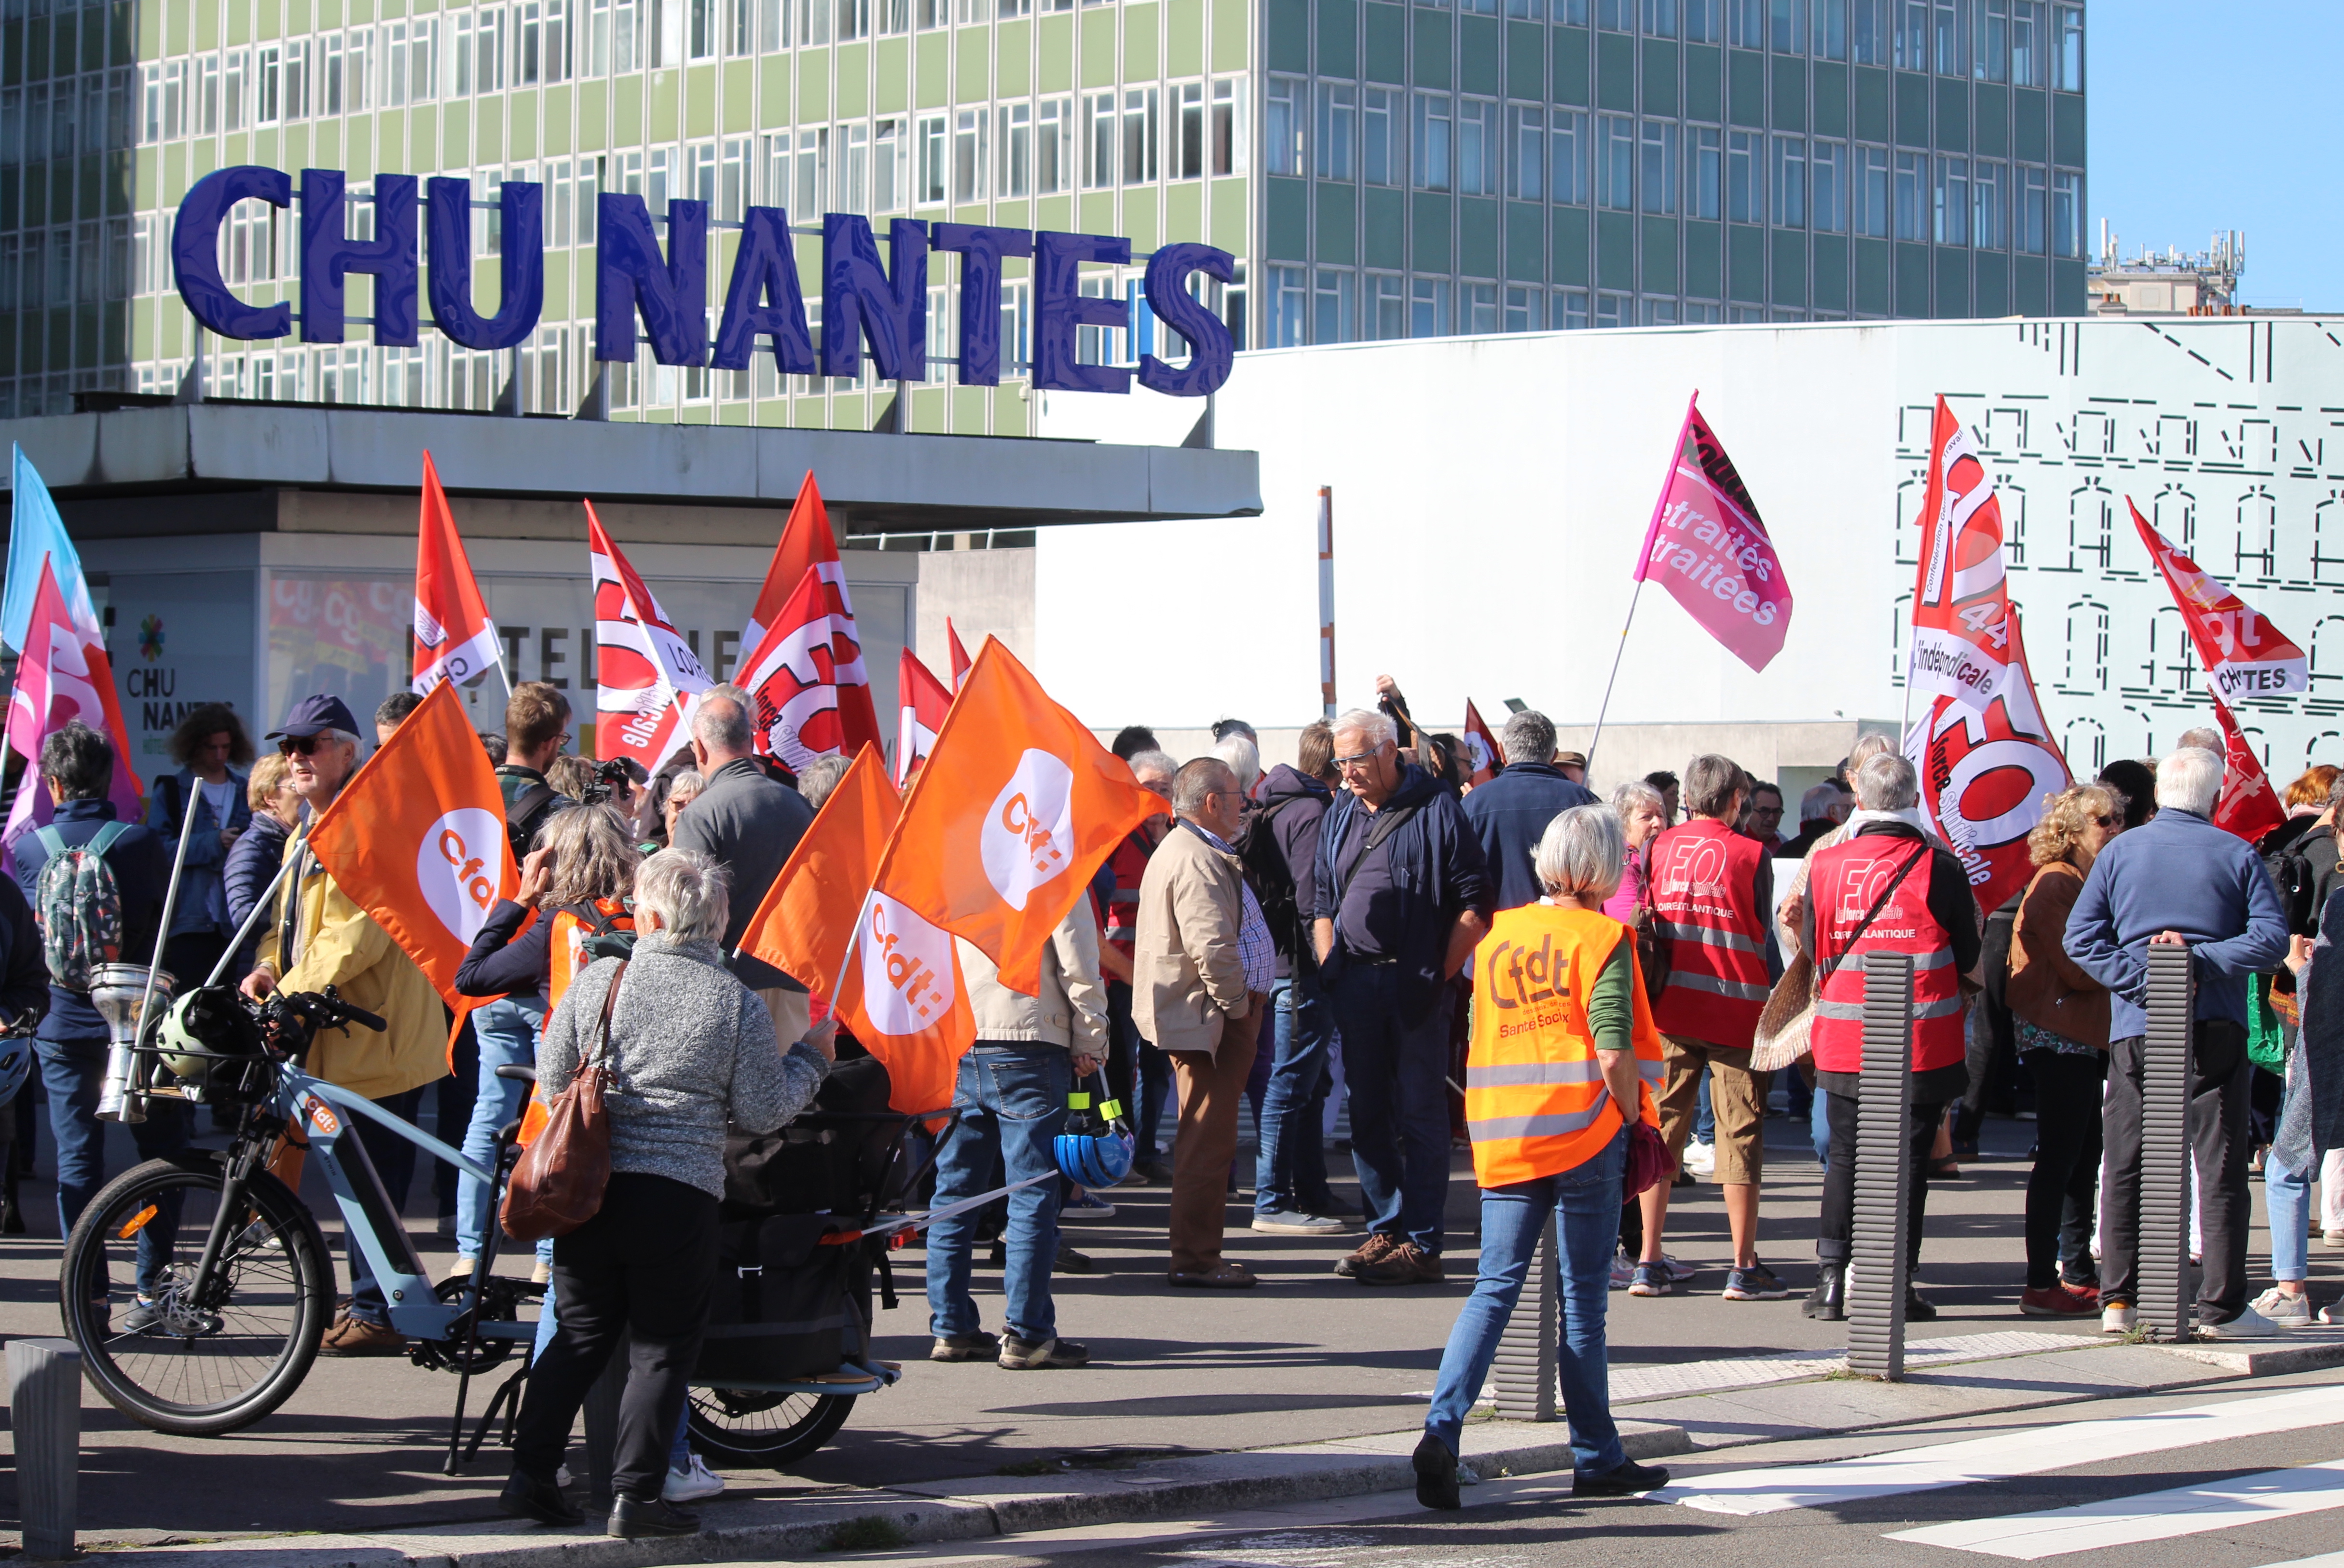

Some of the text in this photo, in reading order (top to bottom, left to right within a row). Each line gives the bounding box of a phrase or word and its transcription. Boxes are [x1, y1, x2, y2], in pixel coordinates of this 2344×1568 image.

[172, 165, 1235, 396] CHU NANTES
[1943, 428, 1964, 459] Travail
[1958, 601, 2008, 650] 44
[127, 668, 175, 697] CHU
[1931, 737, 1951, 792] force
[1935, 791, 1992, 886] syndicale
[439, 829, 497, 916] Cfd
[1660, 835, 1727, 898] FO
[1671, 878, 1688, 893] force
[1688, 881, 1727, 899] syndicale
[1845, 907, 1865, 921] force
[1488, 933, 1570, 1009] Cfdt
[1499, 1017, 1536, 1038] Santé
